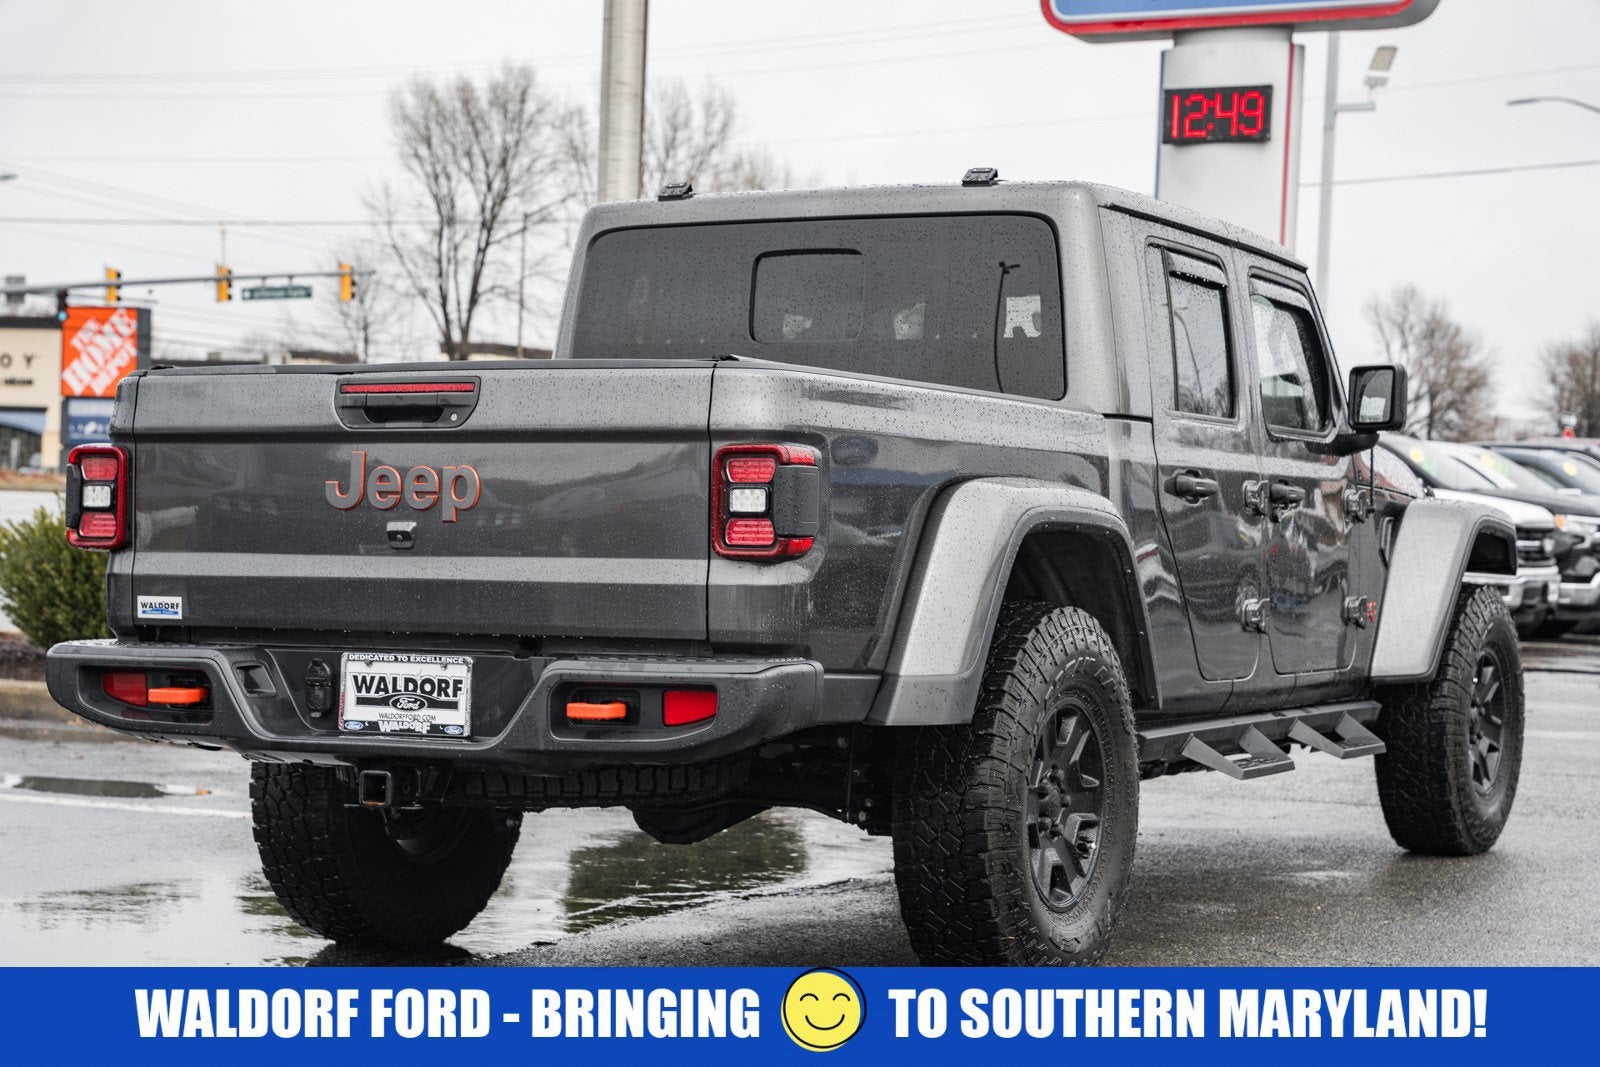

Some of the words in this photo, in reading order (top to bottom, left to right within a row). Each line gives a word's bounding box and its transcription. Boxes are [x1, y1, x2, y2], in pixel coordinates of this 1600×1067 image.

[1171, 91, 1265, 138] 12:49
[62, 308, 138, 395] HOME
[325, 451, 482, 523] Jeep
[140, 601, 180, 610] WALDORF
[348, 653, 395, 662] DEDICATED
[410, 655, 464, 664] EXCELLENCE
[350, 673, 464, 699] WALDORF
[396, 698, 421, 710] Ford
[378, 712, 437, 721] WALDORFFORD.COM
[378, 720, 432, 734] WALDORF
